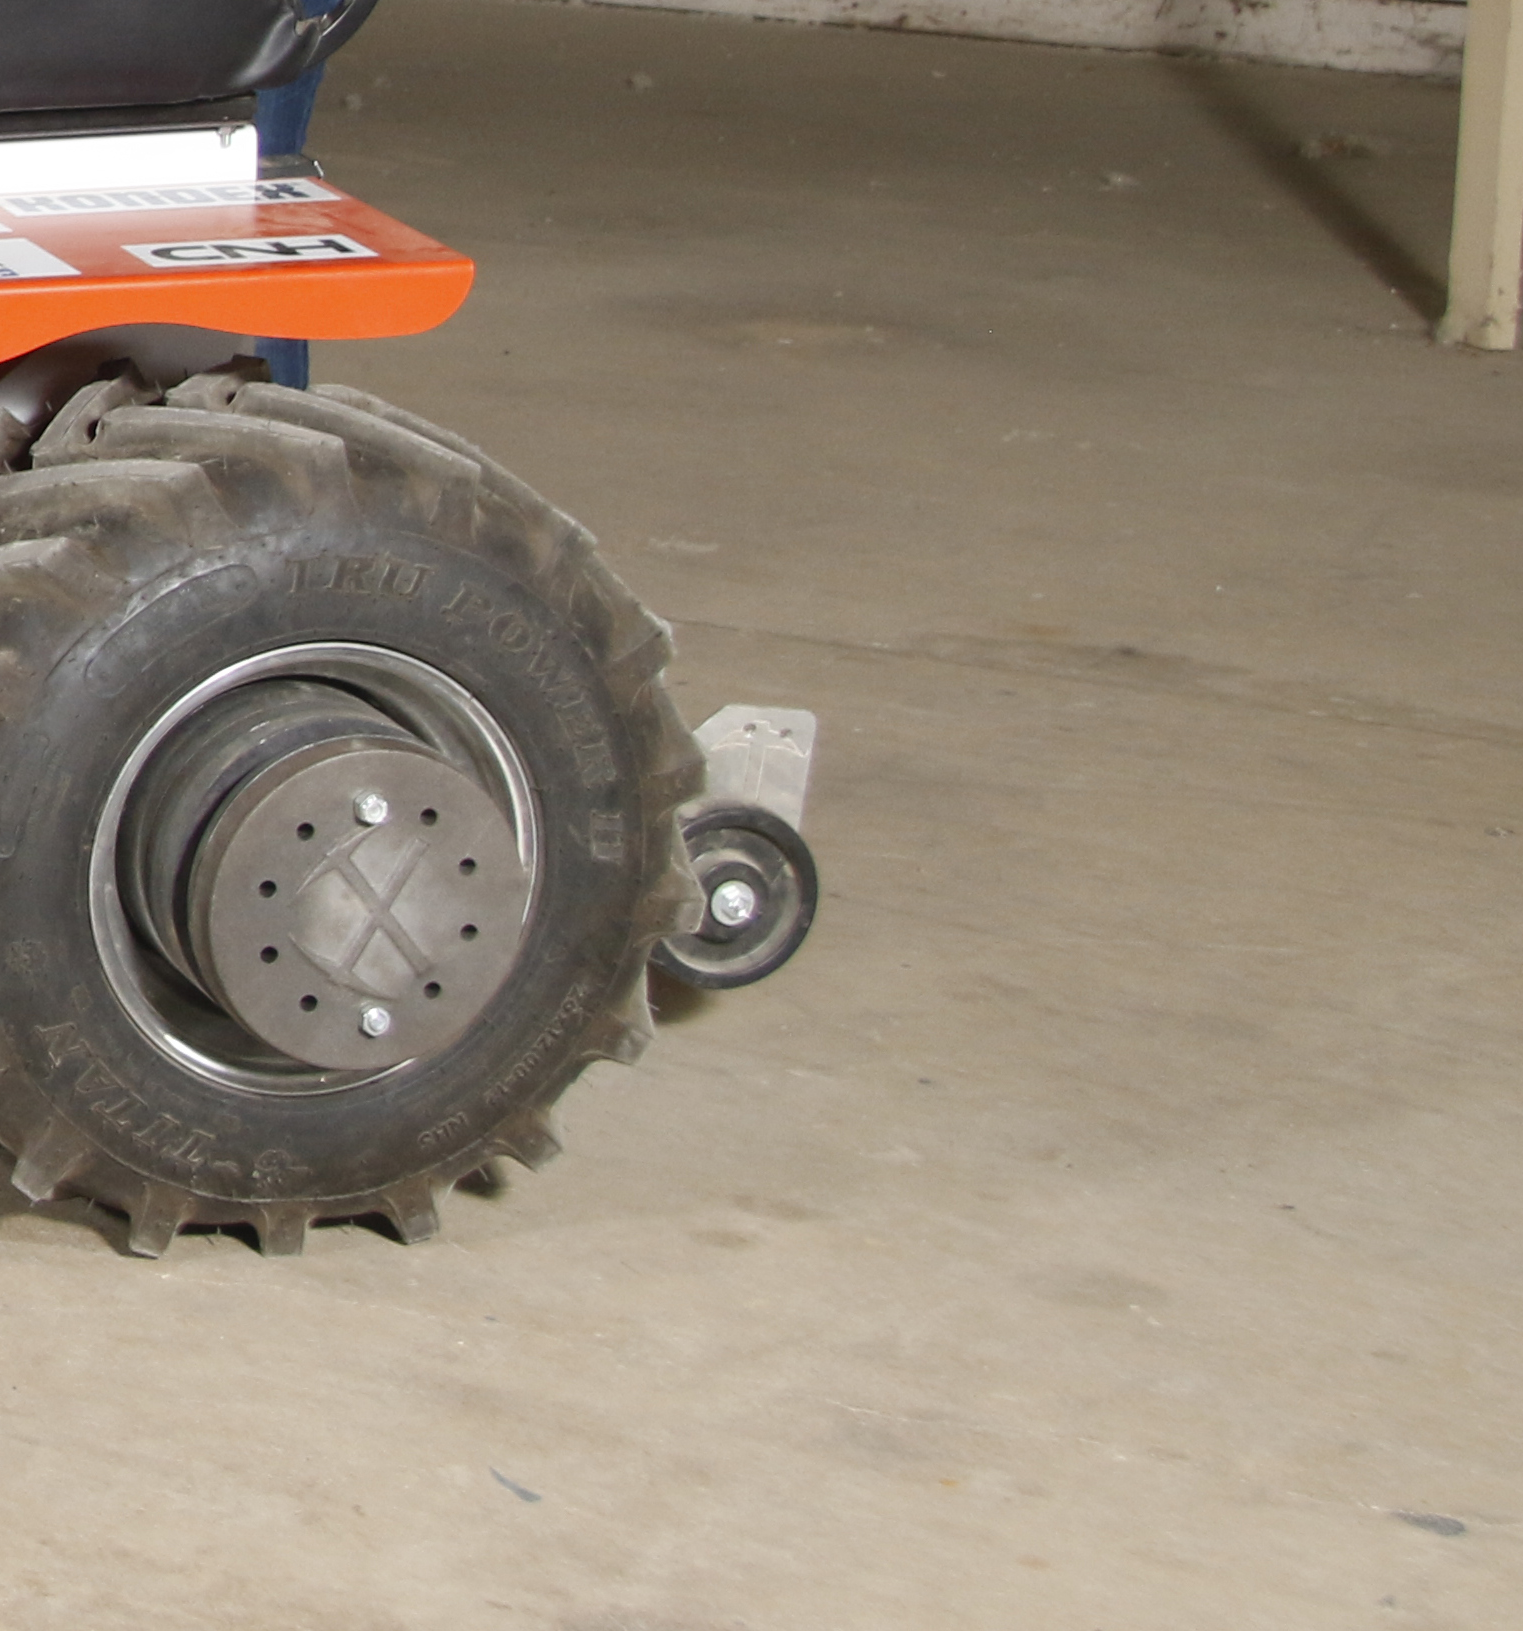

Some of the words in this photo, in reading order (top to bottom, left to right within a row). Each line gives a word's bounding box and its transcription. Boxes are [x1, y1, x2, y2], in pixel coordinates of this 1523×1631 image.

[11, 182, 303, 213] KONDEX
[150, 235, 353, 263] CNH
[283, 552, 434, 599] TRU
